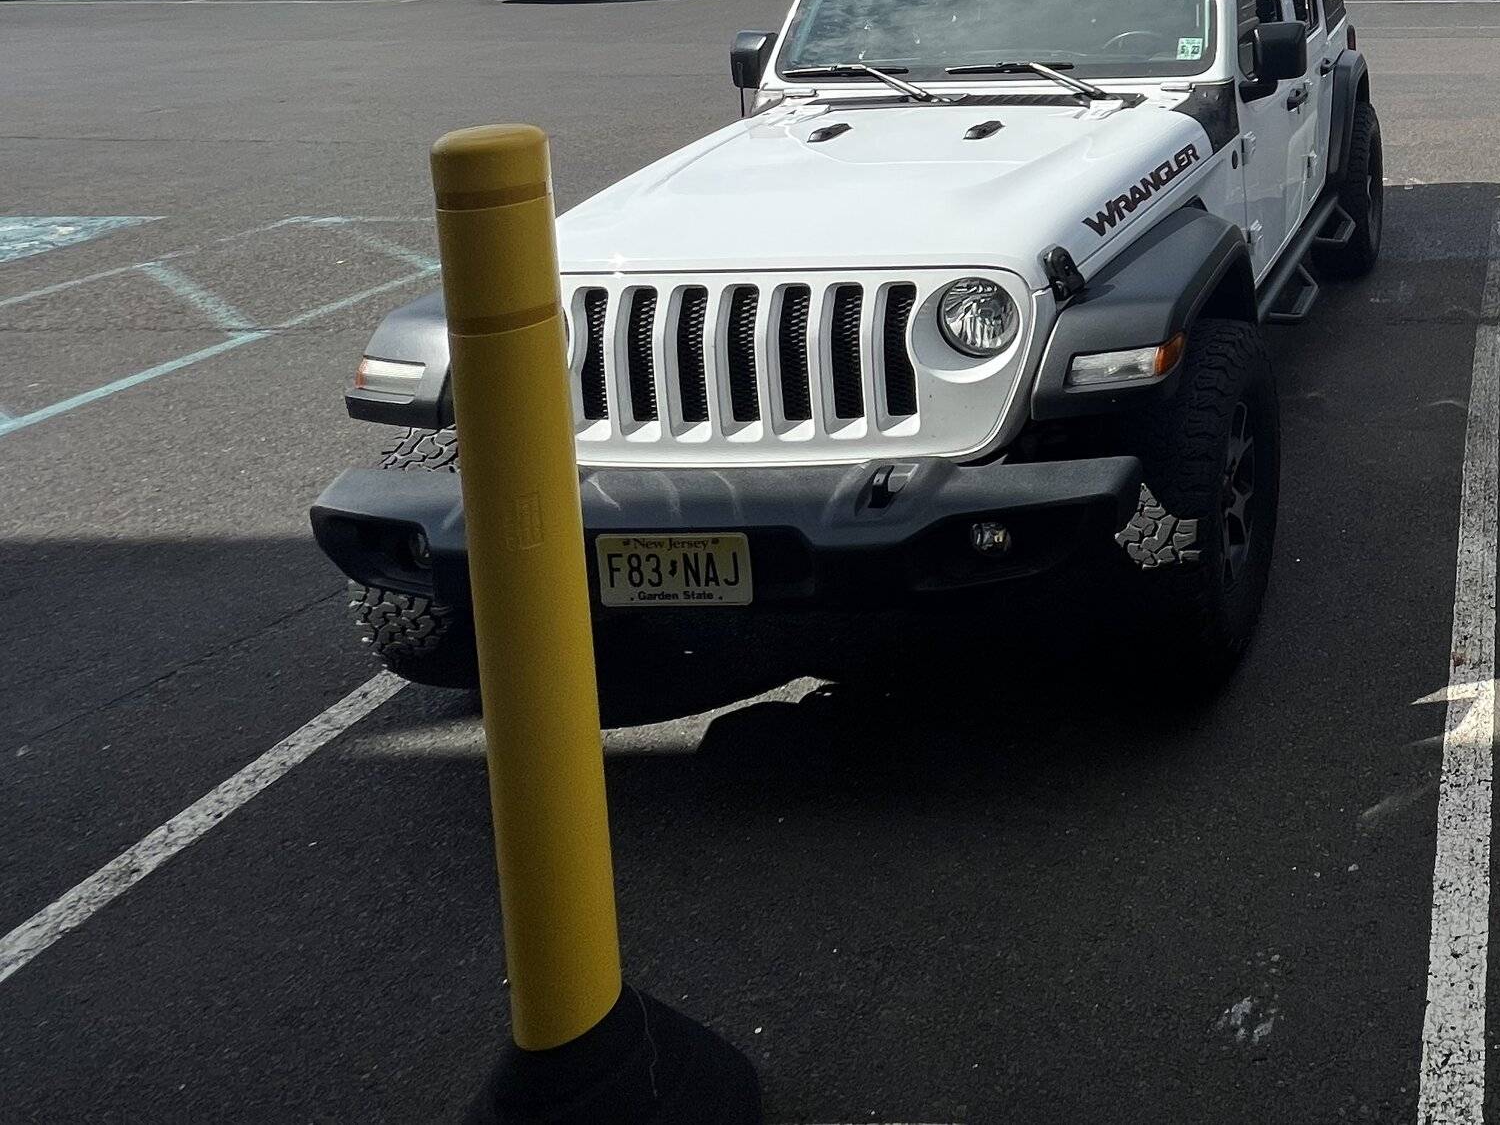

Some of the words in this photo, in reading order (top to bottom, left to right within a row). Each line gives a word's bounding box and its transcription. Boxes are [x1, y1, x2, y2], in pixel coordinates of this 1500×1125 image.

[1082, 143, 1200, 236] WRANGLER
[633, 537, 665, 549] New
[667, 537, 709, 551] Jersey
[606, 553, 663, 588] F83
[682, 551, 740, 588] NAJ
[637, 590, 679, 601] Garden
[682, 590, 714, 600] State
